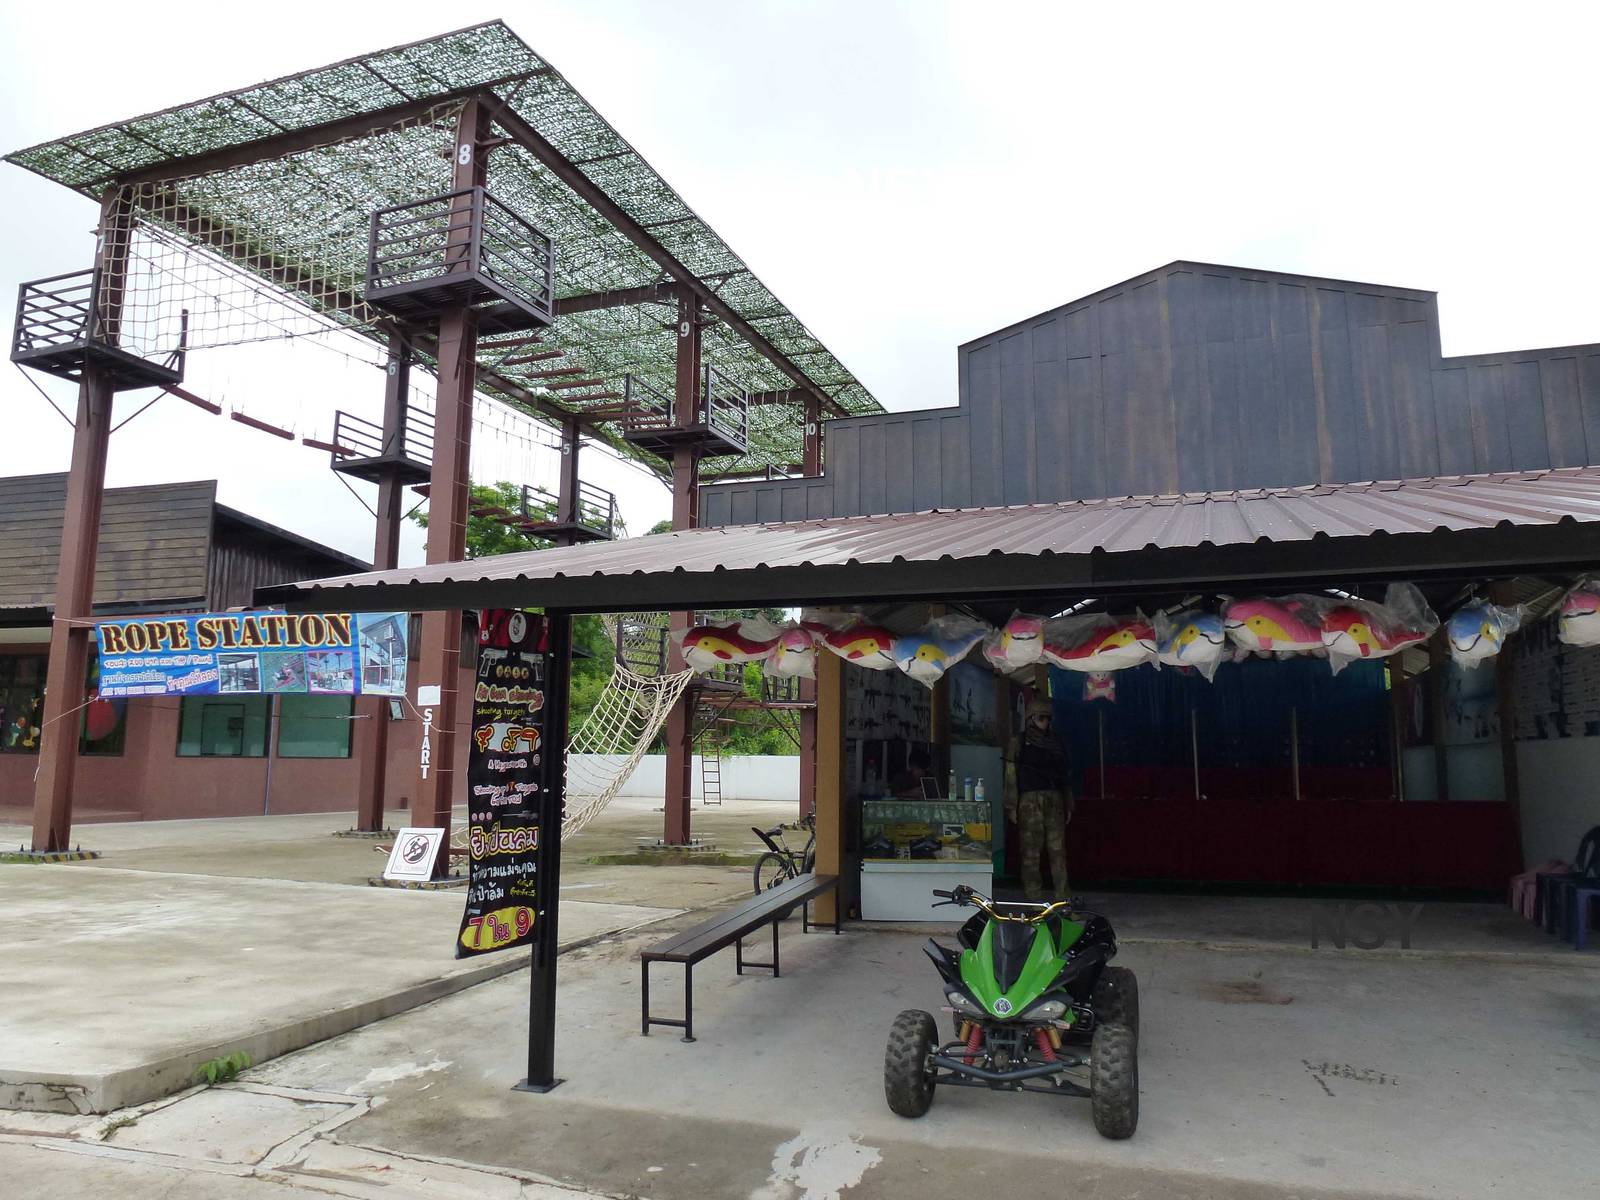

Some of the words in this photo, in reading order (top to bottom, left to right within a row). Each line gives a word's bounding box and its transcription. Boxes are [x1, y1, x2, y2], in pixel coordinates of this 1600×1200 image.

[459, 144, 471, 165] 8
[681, 321, 690, 337] 9
[388, 362, 396, 375] 6
[806, 423, 816, 436] 10
[562, 443, 571, 455] 5
[100, 619, 190, 655] ROPE
[196, 613, 352, 649] STATION
[420, 708, 433, 780] START
[468, 916, 485, 947] 7
[487, 914, 510, 942] ใน
[515, 906, 531, 938] 9
